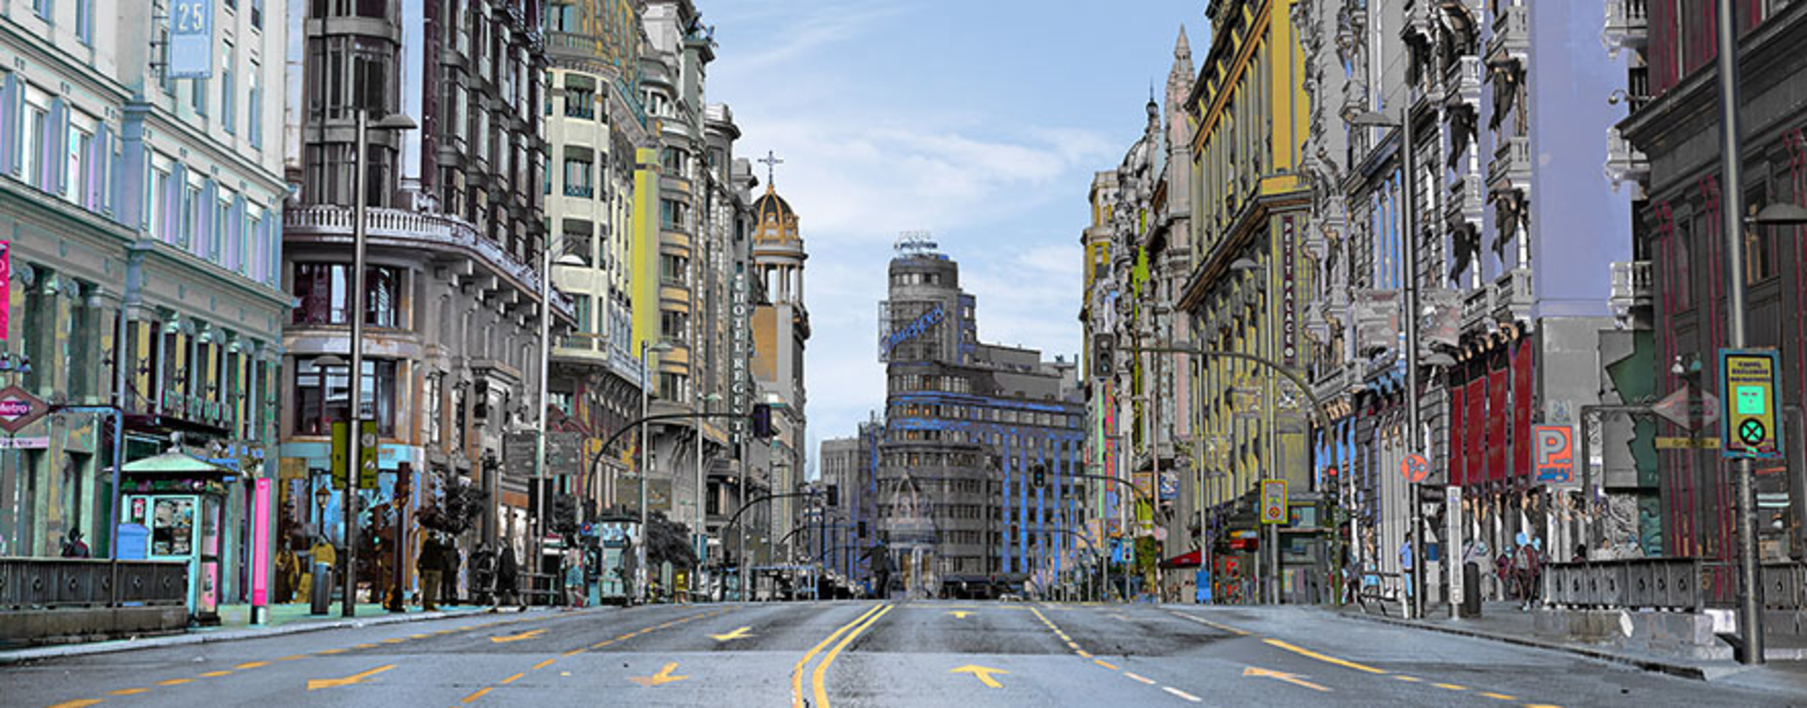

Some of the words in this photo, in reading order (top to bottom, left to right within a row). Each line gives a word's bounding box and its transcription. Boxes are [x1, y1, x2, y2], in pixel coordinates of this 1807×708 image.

[179, 3, 203, 31] 25
[1284, 222, 1293, 275] PETIT
[733, 293, 746, 353] HOTEL
[1284, 280, 1293, 344] PALACE
[1538, 430, 1567, 465] P
